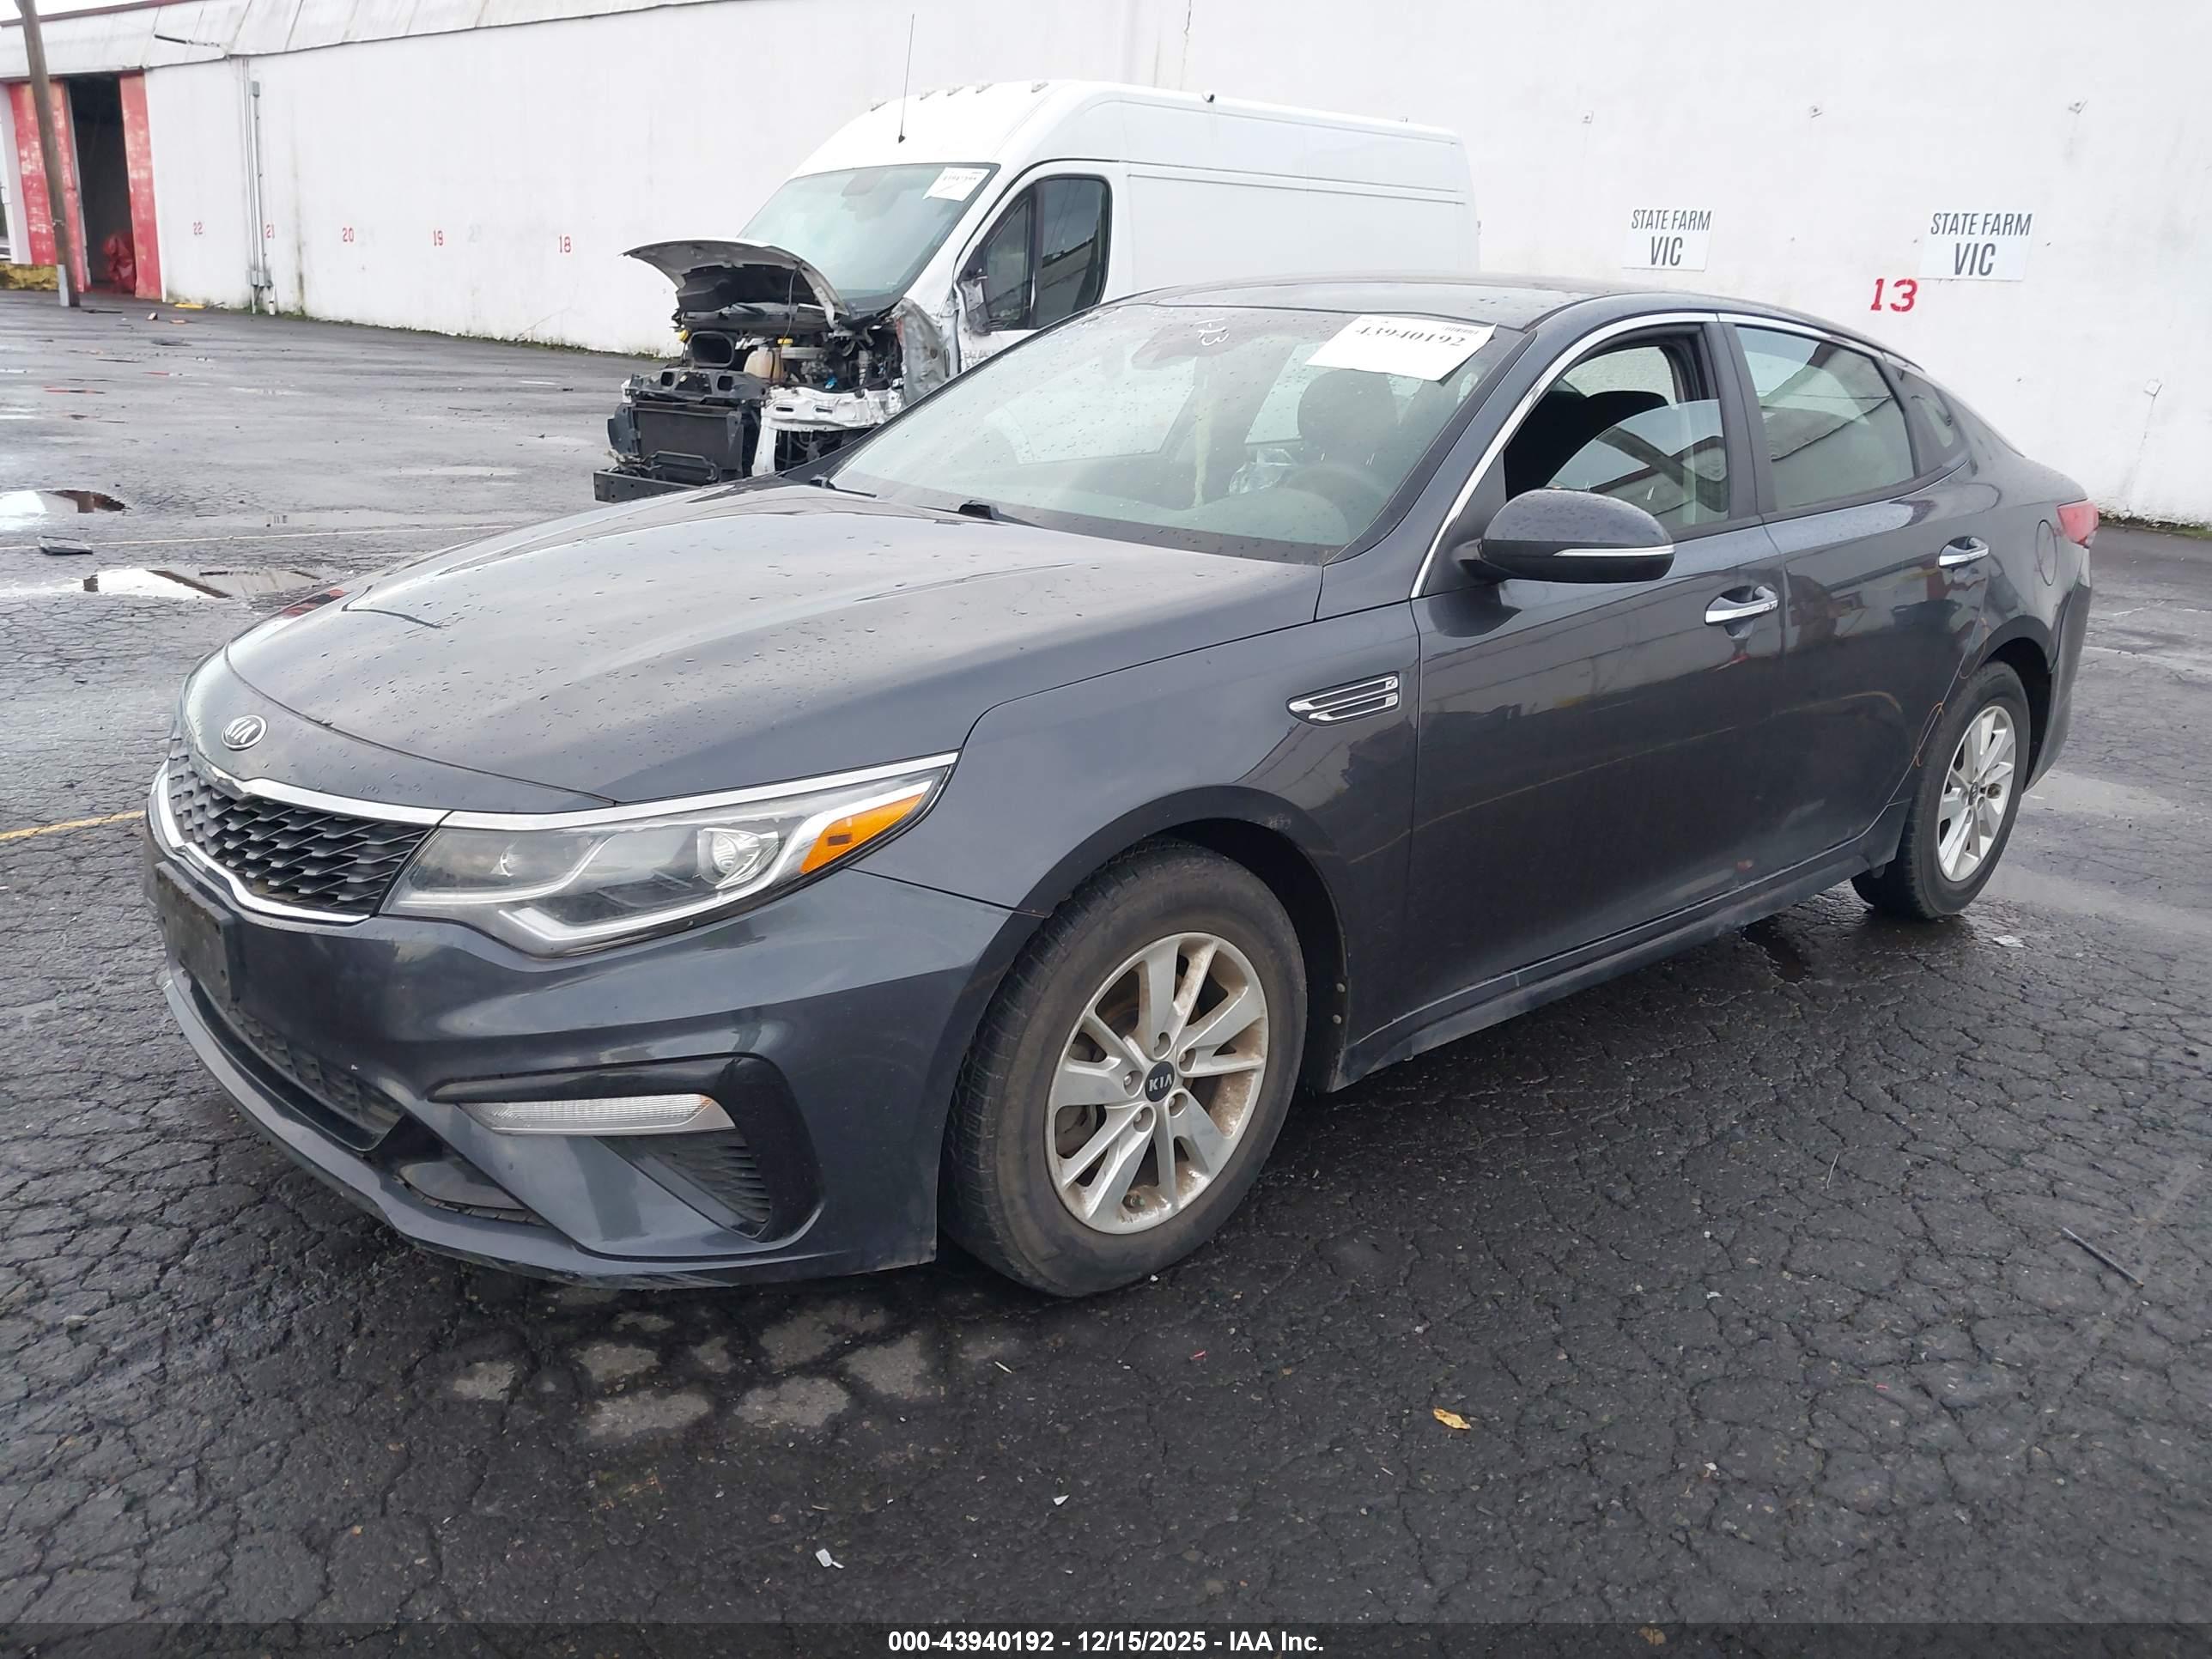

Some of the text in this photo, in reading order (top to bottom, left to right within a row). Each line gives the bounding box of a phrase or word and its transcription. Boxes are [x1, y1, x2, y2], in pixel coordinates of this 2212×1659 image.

[1632, 209, 1712, 231] STATE FARM
[1930, 213, 2033, 236] STATE FARM
[342, 227, 355, 243] 20
[433, 230, 444, 246] 19
[559, 235, 571, 254] 18
[1650, 235, 1684, 267] VIC
[1954, 242, 1996, 276] VIC
[1870, 278, 1918, 313] 13
[1149, 1073, 1172, 1092] KIA
